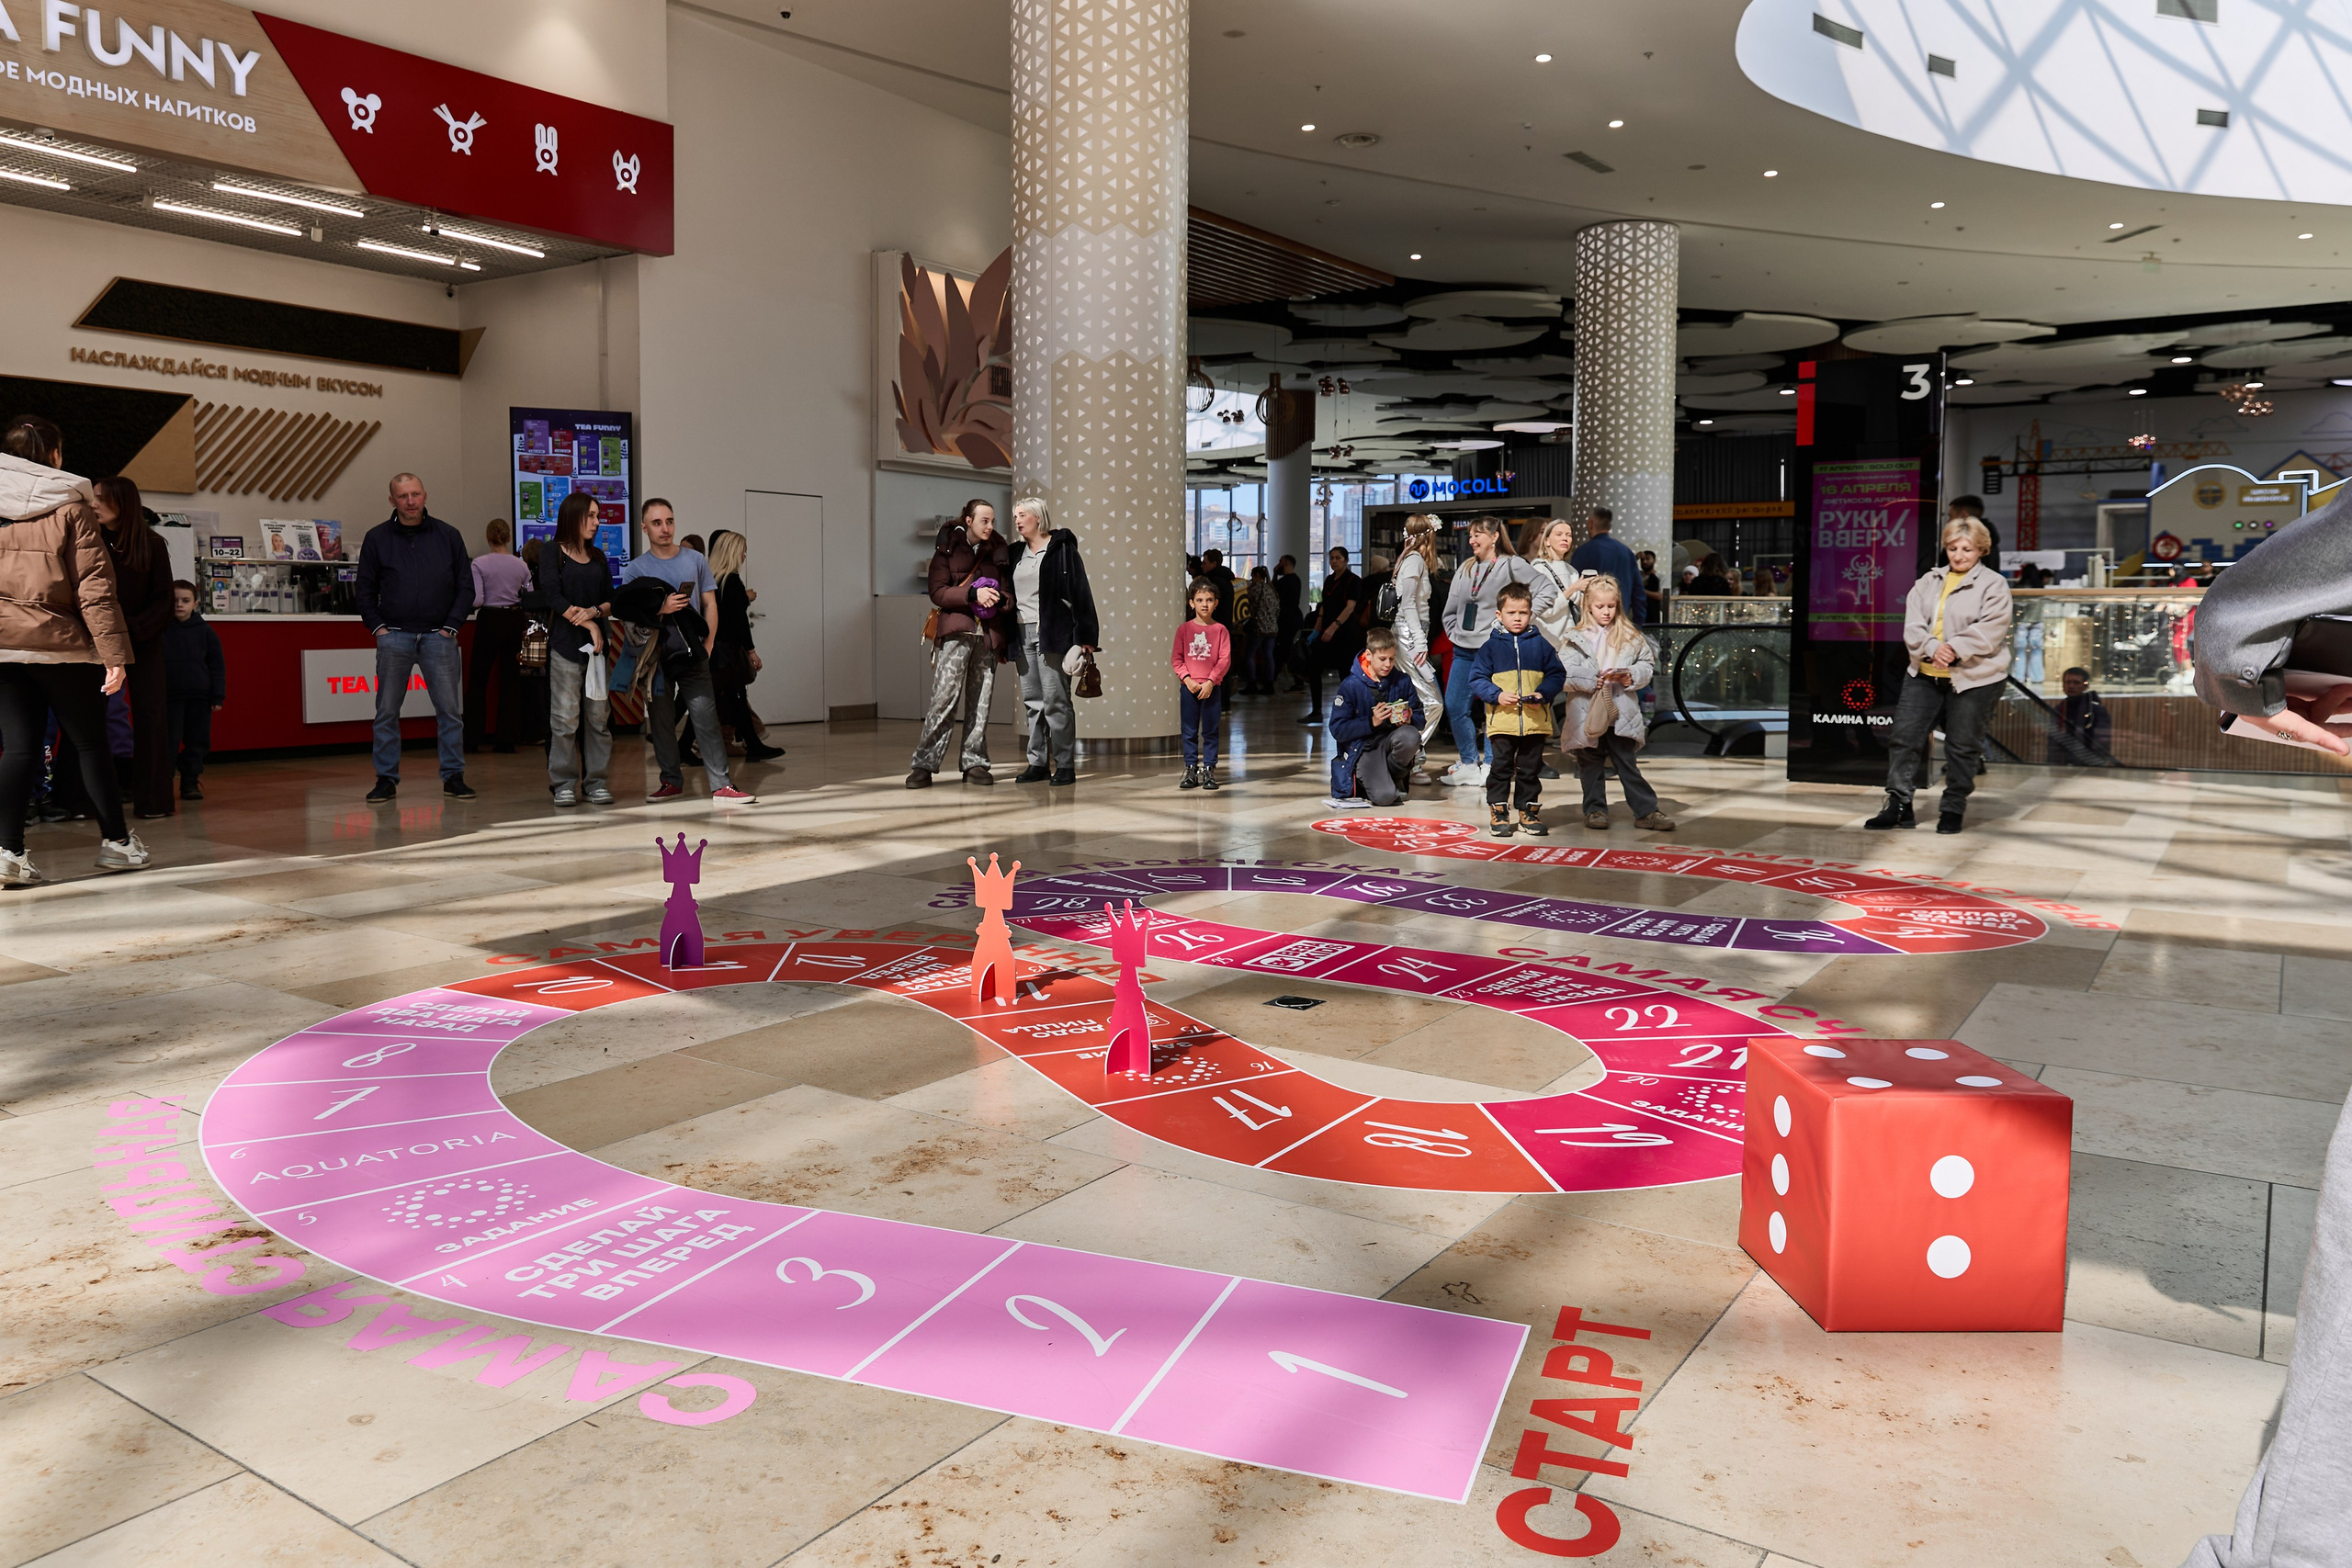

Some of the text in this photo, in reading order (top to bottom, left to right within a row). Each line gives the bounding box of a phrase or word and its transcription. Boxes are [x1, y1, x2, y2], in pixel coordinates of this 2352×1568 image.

[40, 0, 261, 96] FUNNY
[26, 66, 139, 107] МОДНЫХ
[144, 93, 257, 133] НАПИТКОВ
[70, 346, 383, 398] НАСЛАЖДАЙСЯ МОДНЫМ ВКУСОМ
[1900, 364, 1930, 400] 3
[1432, 478, 1509, 495] MOCOLL
[1821, 482, 1911, 494] 16 АПРЕЛЯ
[1823, 497, 1872, 505] ФЕТИСОВ
[1819, 509, 1888, 529] РУКИ
[327, 676, 369, 694] TEA
[1813, 714, 1863, 725] КАЛИНА
[1057, 858, 1447, 879] ТВОРЧЕСКАЯ
[1046, 877, 1154, 895] TEA FUNNY
[1343, 881, 1408, 897] 32
[1656, 845, 2121, 931] САМАЯ КРАСИВАЯ
[1794, 876, 1857, 889] 40
[1029, 897, 1091, 910] 28
[1425, 892, 1487, 910] 33
[1501, 904, 1551, 918] ЗАДАНИЕ
[1911, 909, 2017, 918] СДЕЛАЙ
[1958, 915, 2032, 925] ШАГА
[1613, 917, 1657, 934] НАЗАД
[1641, 919, 1679, 936] ШАГОВ
[1668, 923, 1700, 936] ПЯТЬ
[1687, 923, 1727, 943] СДЕЛАЙ
[1912, 917, 2018, 931] ВПЕРЕД
[1154, 928, 1226, 951] 26
[784, 929, 1167, 985] УВЕРННАЯ
[795, 953, 866, 968] 12
[1299, 944, 1347, 959] KIDS
[861, 954, 938, 981] ВПЕРЕД
[887, 963, 953, 980] ШАГА
[1028, 964, 1047, 973] 13
[1377, 955, 1459, 984] 24
[1497, 946, 1770, 1005] САМАЯ
[513, 976, 614, 995] 10
[1476, 969, 1547, 993] СДЕЛАЙ
[1493, 975, 1573, 996] ЧЕТЫРЕ
[1449, 989, 1474, 998] 23
[1525, 983, 1592, 998] ШАГА
[1535, 986, 1626, 1003] НАЗАД
[368, 1007, 523, 1027] ДВА ШАГА
[409, 1001, 534, 1018] СДЕЛАЙ
[1605, 1004, 1692, 1032] 22
[372, 1017, 481, 1033] НАЗАД
[1001, 1019, 1097, 1033] ПИЦЦА
[1032, 1024, 1105, 1038] ДОДО
[1181, 1024, 1203, 1033] 15
[342, 1042, 417, 1068] 8
[1075, 1042, 1193, 1060] ЗАДИЕ
[1668, 1043, 1747, 1070] 21
[1250, 1060, 1274, 1073] 16
[1618, 1075, 1659, 1087] 20
[312, 1086, 380, 1121] 7
[1211, 1088, 1294, 1132] 17
[1631, 1100, 1746, 1133] ЗАДАНИ
[1363, 1120, 1473, 1157] 18
[1535, 1122, 1674, 1147] 19
[229, 1146, 250, 1160] 6
[249, 1129, 517, 1186] AQUATORIA
[298, 1210, 318, 1226] 5
[435, 1198, 599, 1254] ЗАДАНИЕ
[504, 1205, 679, 1282] СДЕЛАЙ
[94, 1093, 757, 1427] САМАЯ СТИЛЬНАЯ
[516, 1207, 732, 1300] ТРИ ШАГА
[580, 1223, 756, 1302] ВПЕРЕД
[438, 1274, 468, 1288] 4
[775, 1256, 876, 1311] 3
[1005, 1293, 1128, 1359] 2
[1267, 1349, 1408, 1400] 1
[1496, 1305, 1652, 1559] СТАРТ
